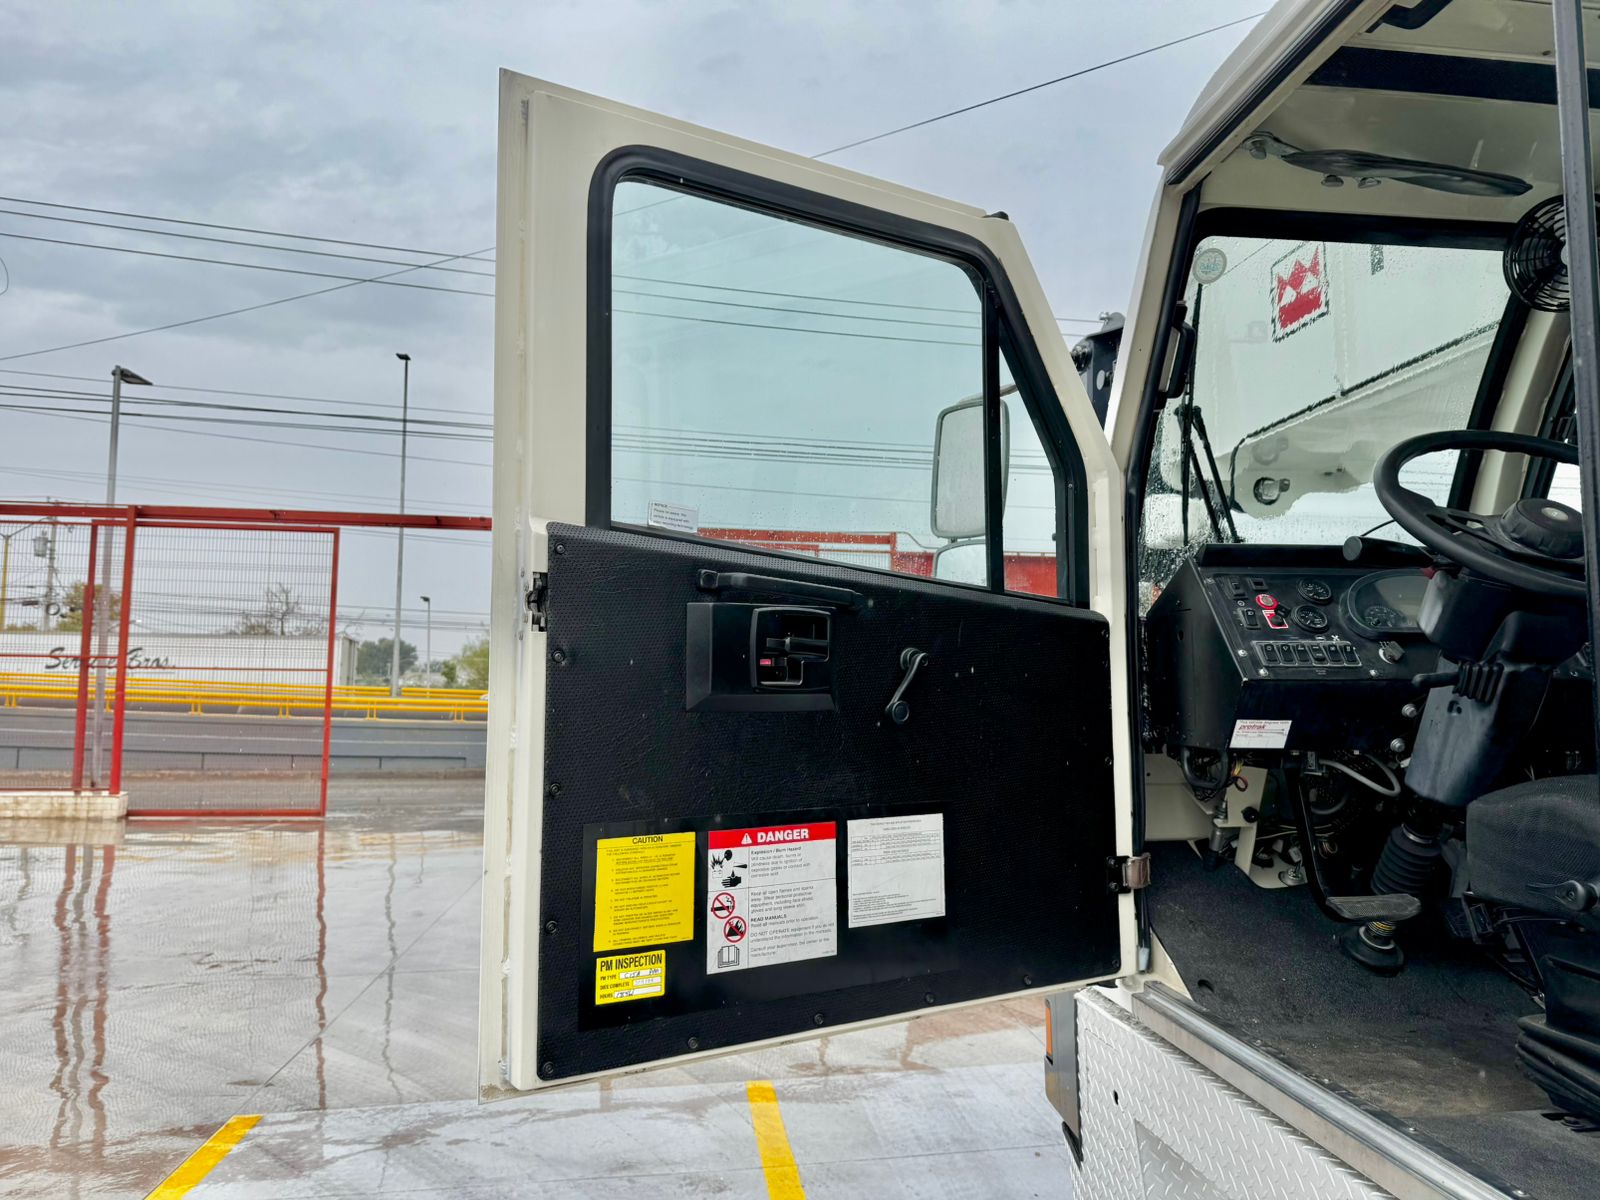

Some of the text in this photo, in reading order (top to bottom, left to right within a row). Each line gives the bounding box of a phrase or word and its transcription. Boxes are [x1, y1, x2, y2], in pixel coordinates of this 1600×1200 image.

[632, 835, 664, 844] CAUTION
[757, 828, 809, 843] DANGER
[600, 953, 662, 972] PM INSPECTION
